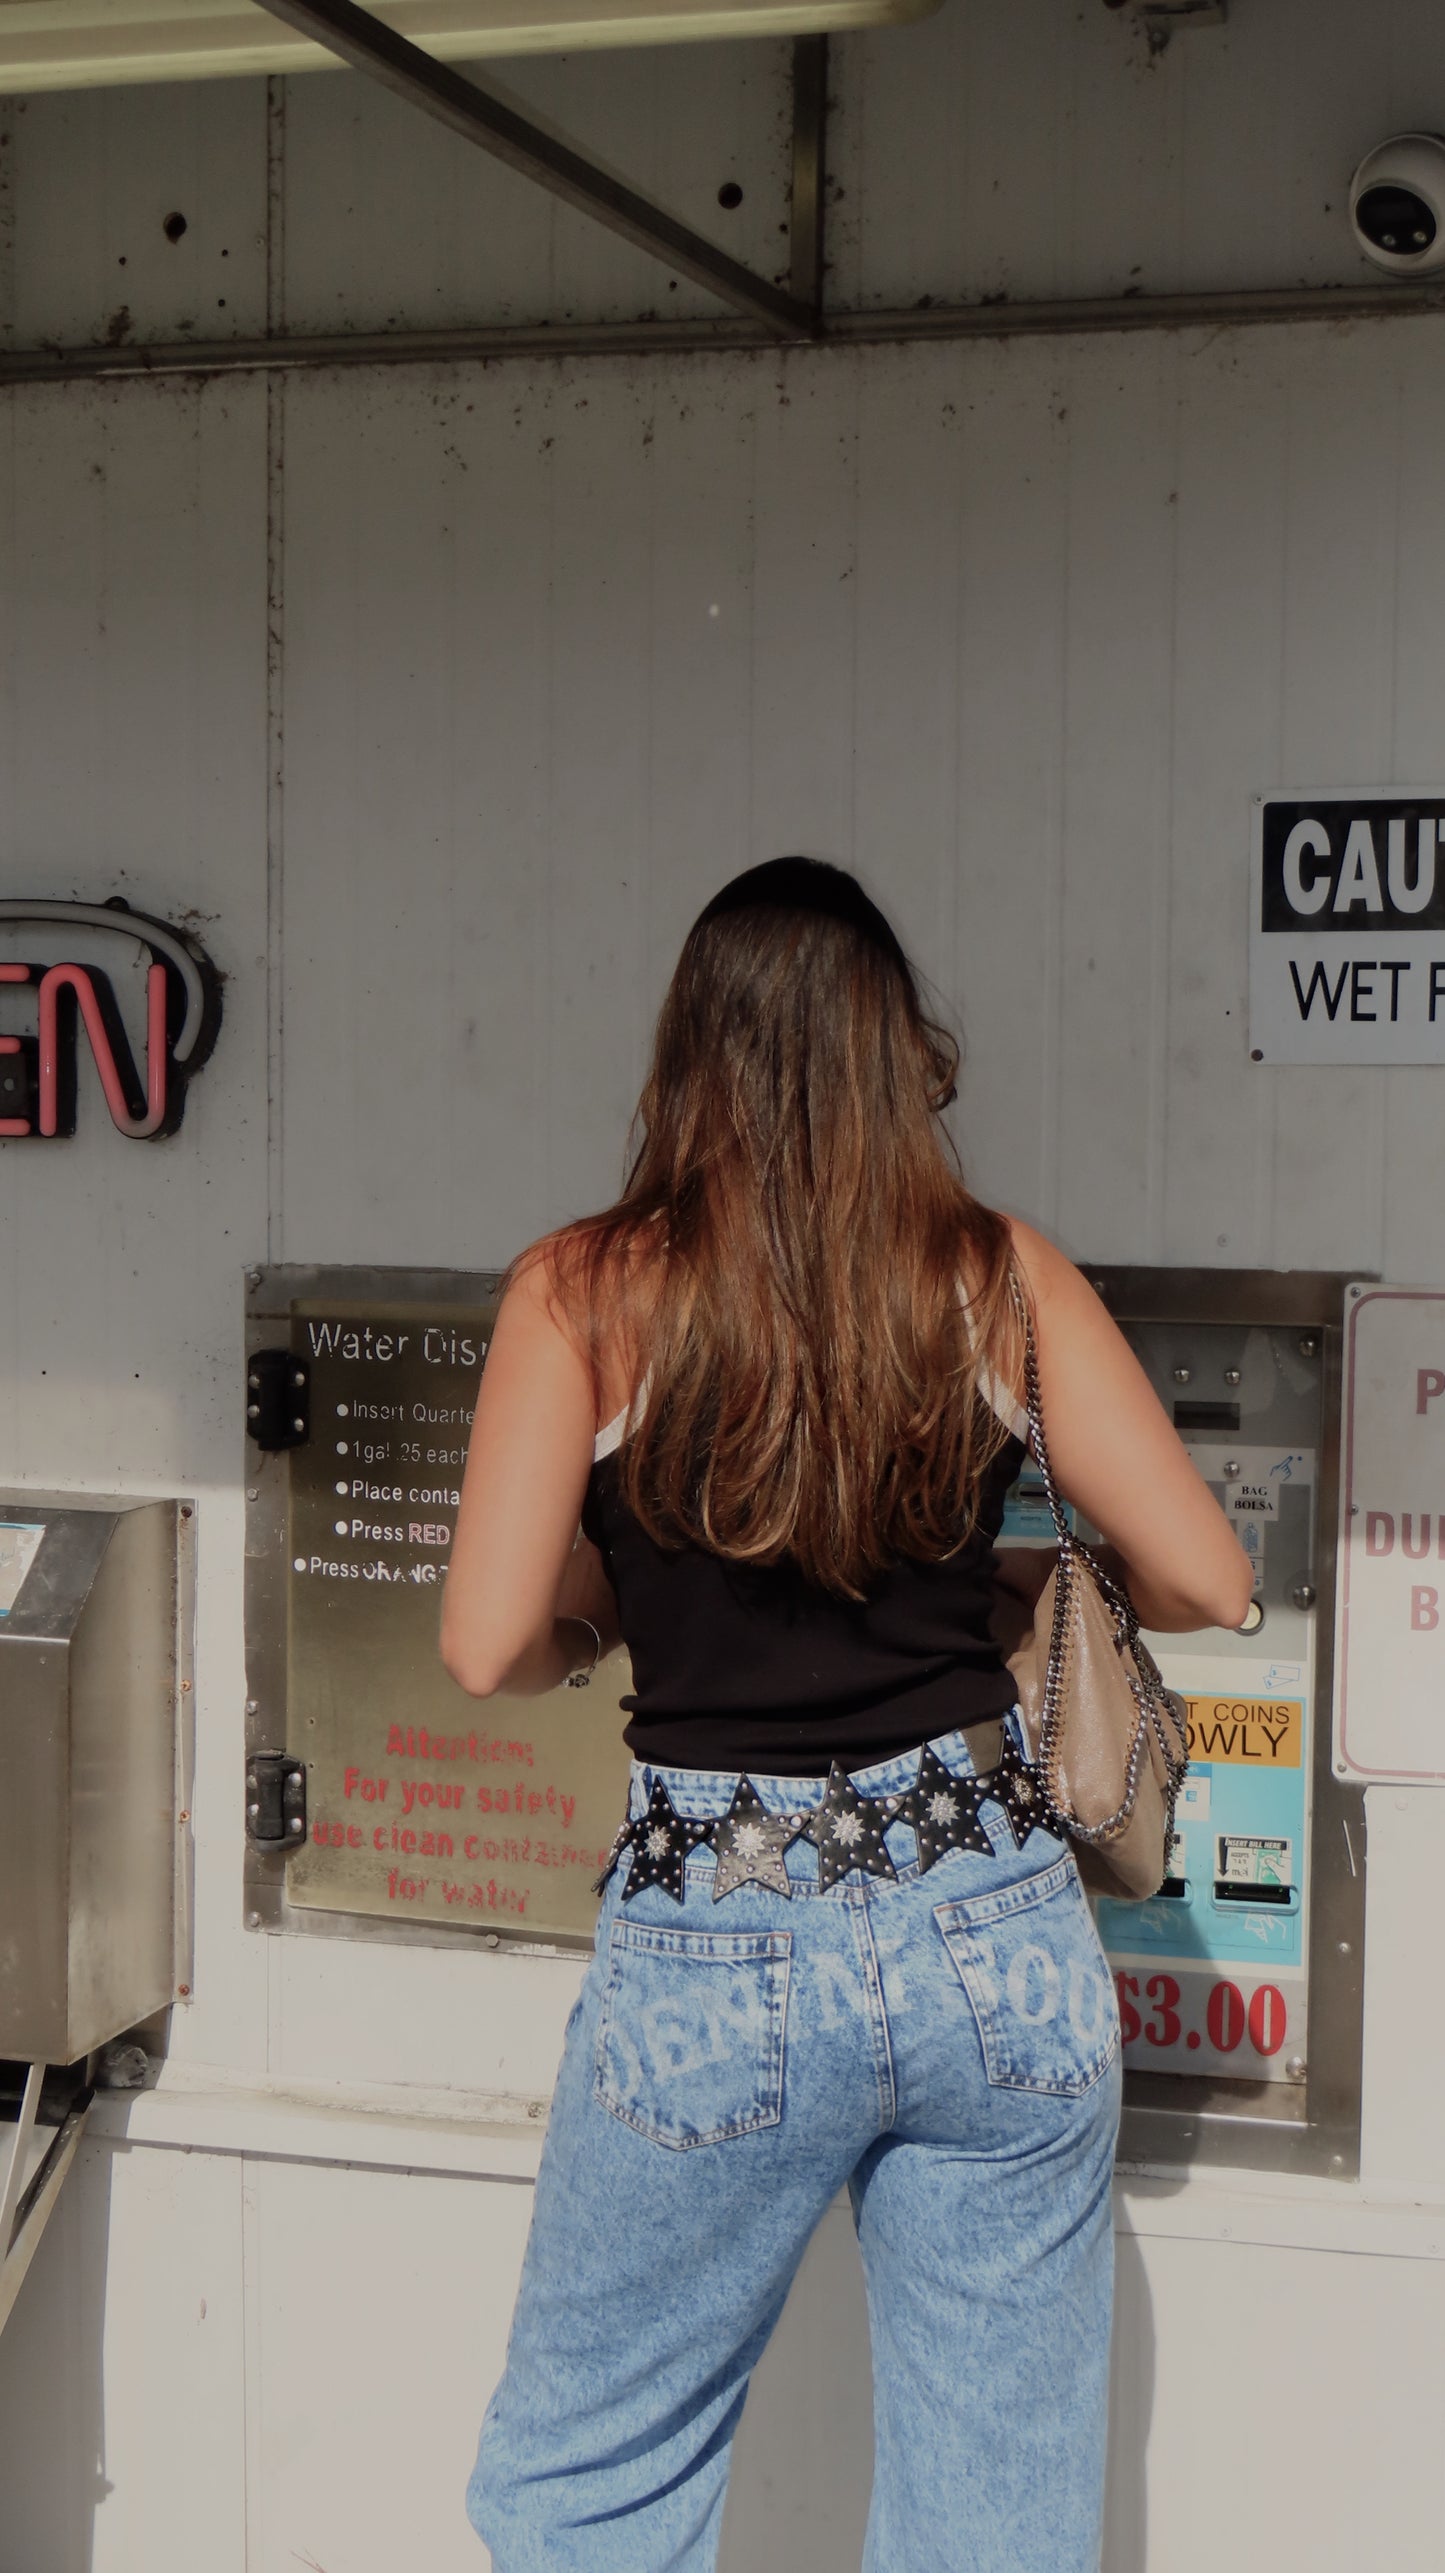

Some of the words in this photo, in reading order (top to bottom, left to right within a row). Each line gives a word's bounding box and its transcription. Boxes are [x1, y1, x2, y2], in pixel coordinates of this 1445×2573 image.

[1288, 960, 1411, 1022] WET
[308, 1321, 409, 1362] Water
[353, 1399, 404, 1421] Insert
[351, 1479, 402, 1501] Place
[409, 1487, 461, 1506] conta
[1241, 1486, 1268, 1496] BAG
[1234, 1499, 1274, 1512] BOLSA
[351, 1520, 404, 1542] Press
[408, 1522, 450, 1546] RED
[1365, 1511, 1445, 1560] DU
[310, 1556, 359, 1579] Press
[1213, 1702, 1290, 1725] COINS
[344, 1767, 389, 1803] For
[402, 1779, 465, 1815] your
[477, 1781, 576, 1829] safety
[312, 1820, 362, 1848] use
[373, 1821, 454, 1857] clean
[1225, 1837, 1249, 1848] INSERT
[1249, 1840, 1263, 1849] BILL
[1263, 1841, 1282, 1850] HERE
[387, 1866, 431, 1902] for
[1116, 1971, 1287, 2057] $3.00
